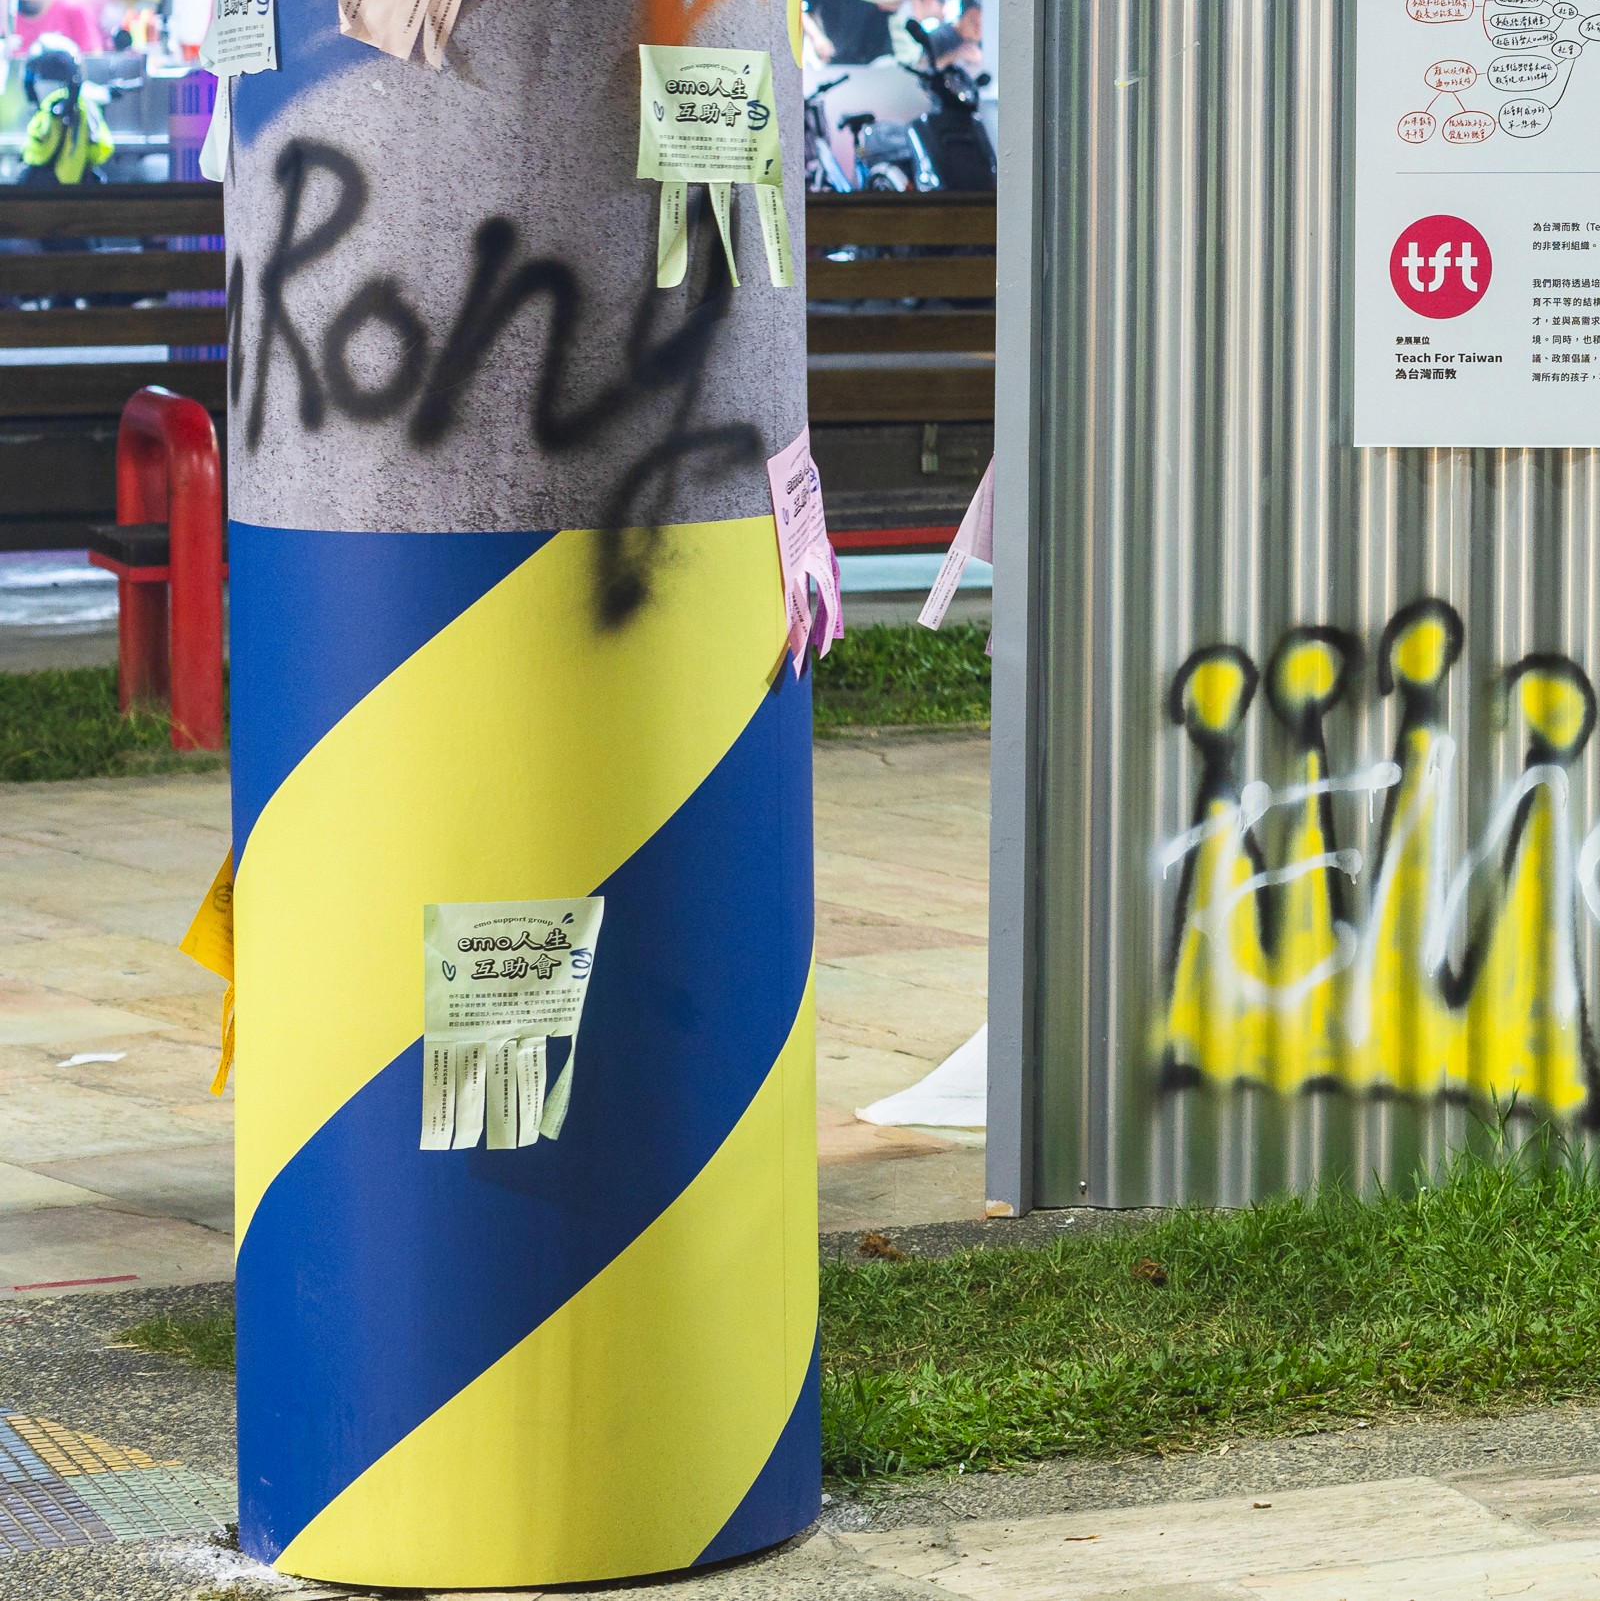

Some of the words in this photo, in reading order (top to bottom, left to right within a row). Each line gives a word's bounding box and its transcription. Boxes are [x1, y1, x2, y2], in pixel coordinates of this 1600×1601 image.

[665, 78, 748, 99] emo人生
[676, 102, 742, 126] 互助會
[1532, 240, 1597, 251] 的非營利組織。
[1402, 242, 1478, 293] tft
[1396, 336, 1430, 345] 參展單位
[1394, 352, 1432, 363] Teach
[1434, 353, 1456, 363] For
[1457, 352, 1503, 363] Taiwan
[1395, 367, 1457, 380] 為台灣而教
[473, 920, 491, 929] emo
[458, 929, 572, 952] emo人生
[472, 954, 562, 979] 互助會
